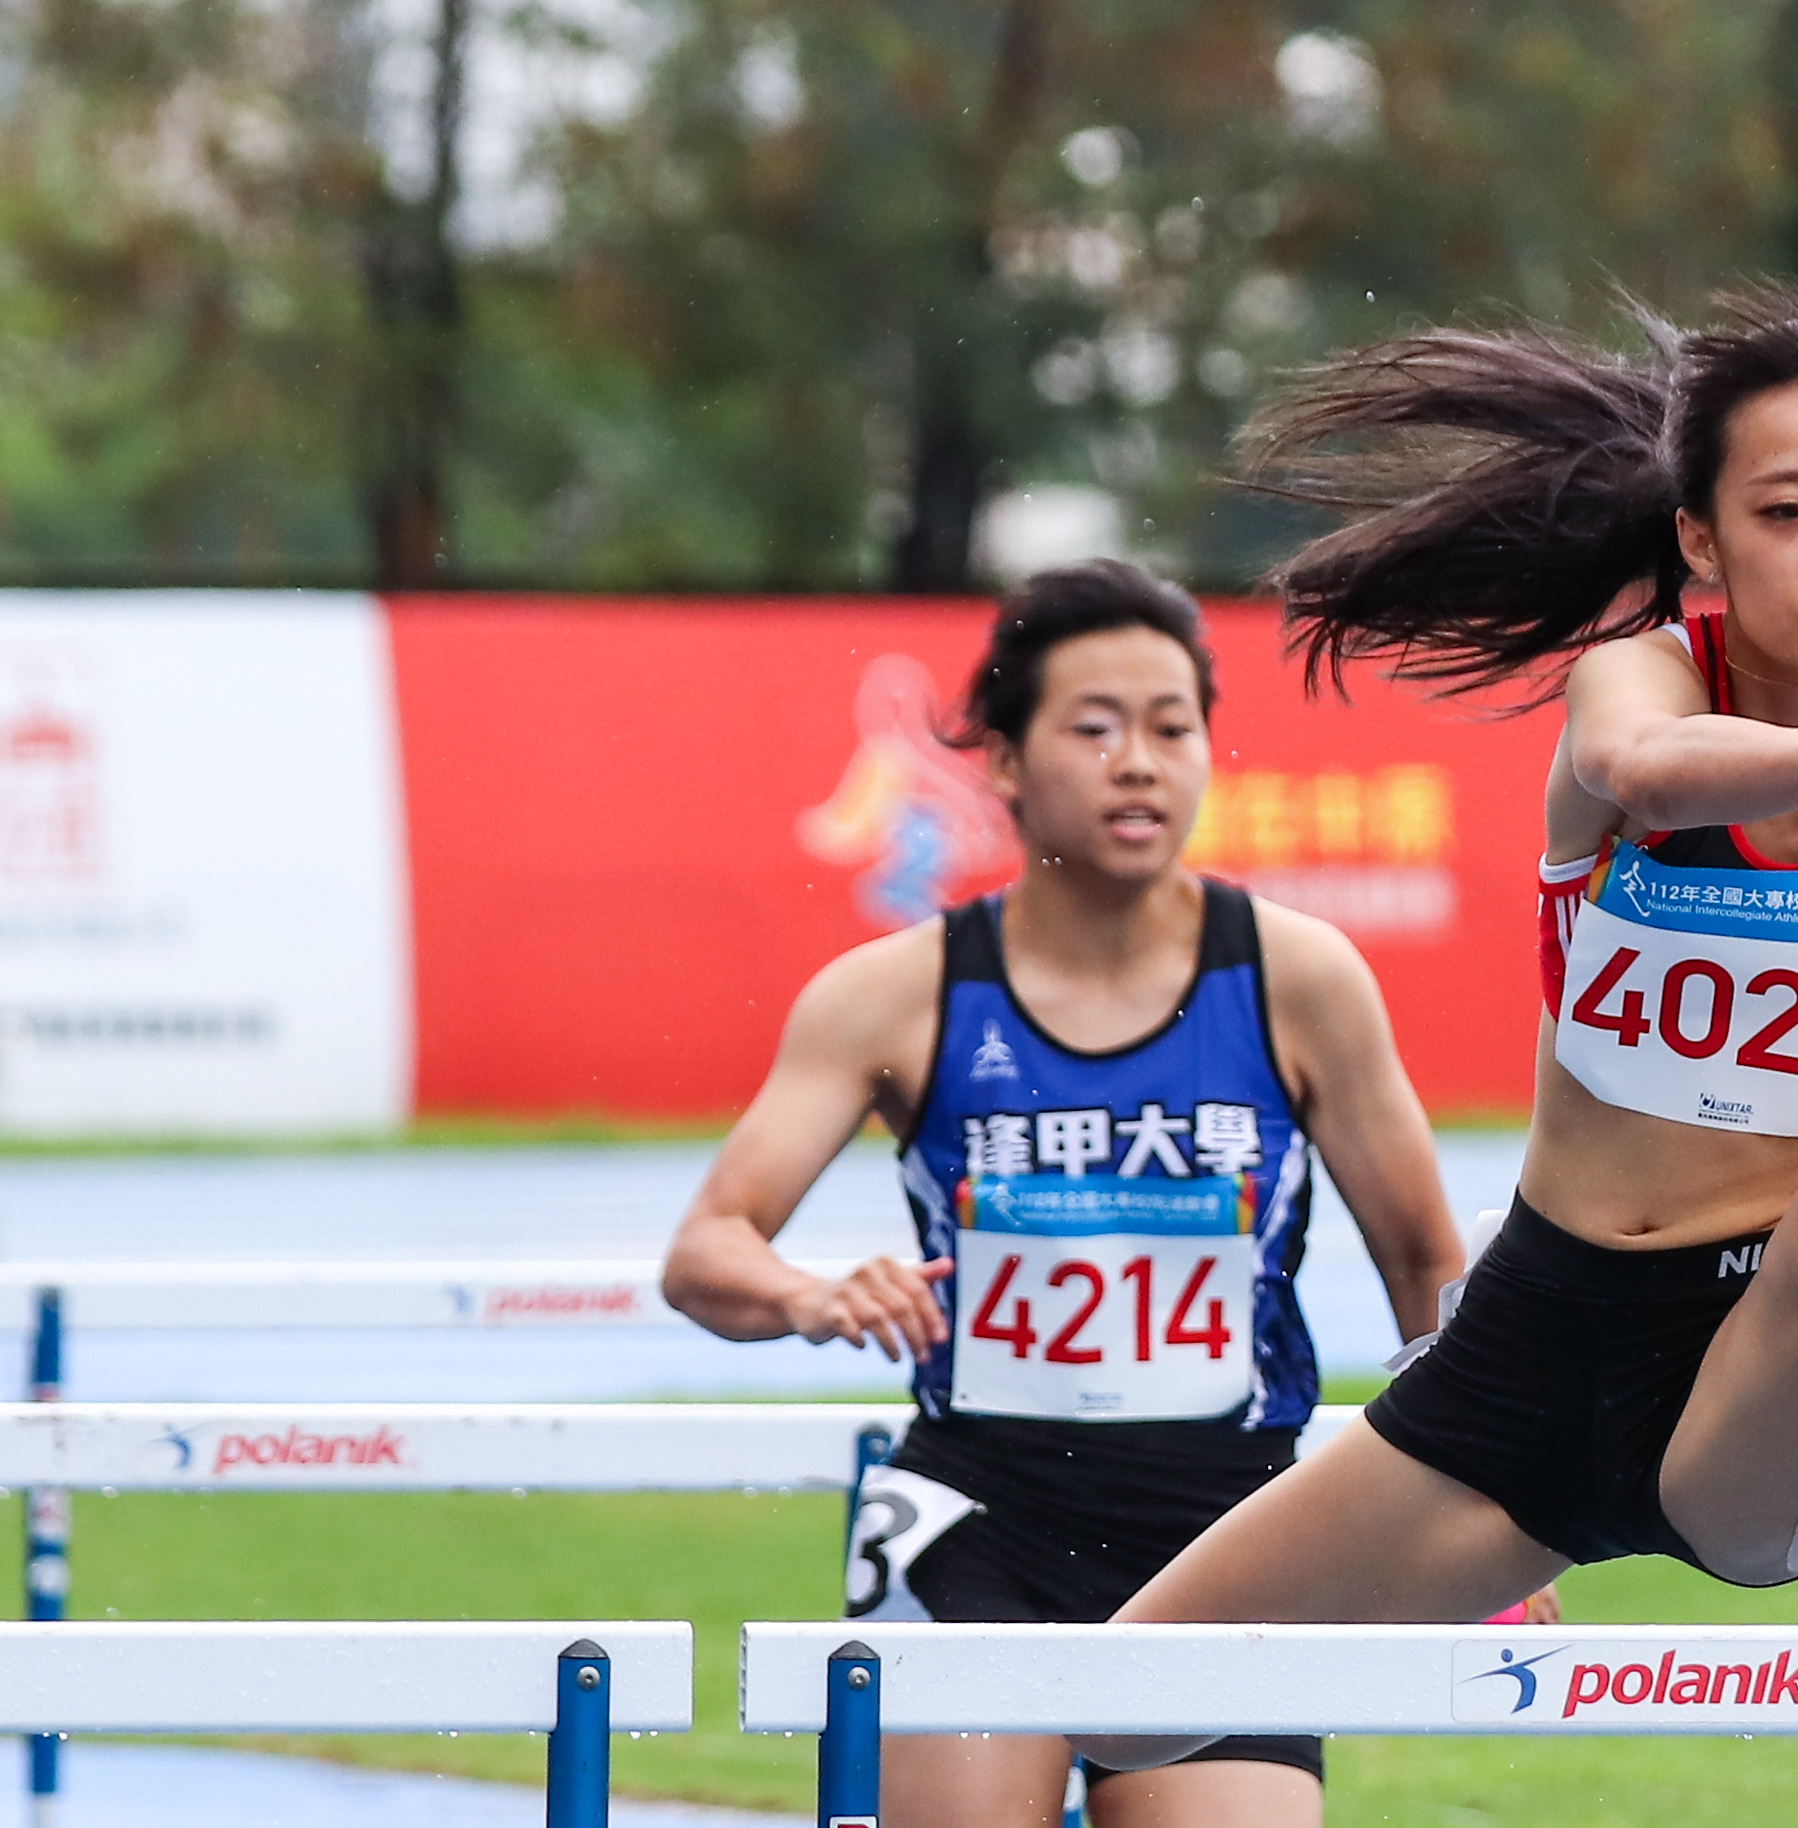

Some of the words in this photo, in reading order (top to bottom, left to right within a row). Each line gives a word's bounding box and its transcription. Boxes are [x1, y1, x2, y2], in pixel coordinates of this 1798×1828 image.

[1646, 898, 1692, 914] National
[1694, 904, 1773, 921] Intercollegiate
[963, 1102, 1263, 1180] 逢甲大學
[1717, 1243, 1764, 1278] NI
[970, 1255, 1231, 1364] 4214
[212, 1424, 404, 1476] polanik
